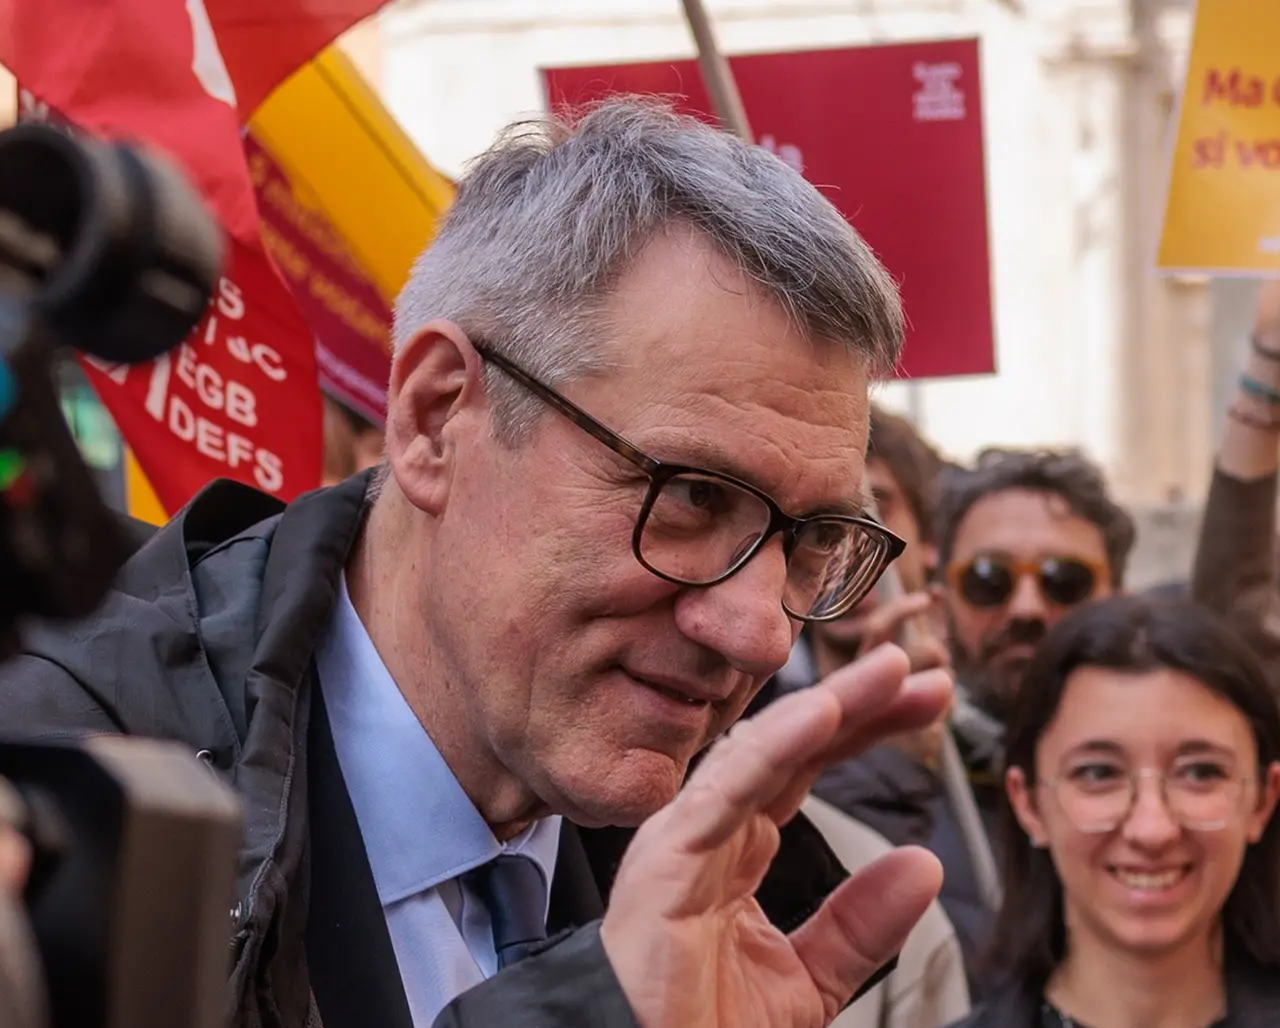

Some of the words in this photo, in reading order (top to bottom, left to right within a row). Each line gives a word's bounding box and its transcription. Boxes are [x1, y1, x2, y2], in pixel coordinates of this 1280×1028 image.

[1202, 67, 1264, 110] Ma
[1190, 130, 1228, 171] si
[169, 394, 283, 492] DEFS
